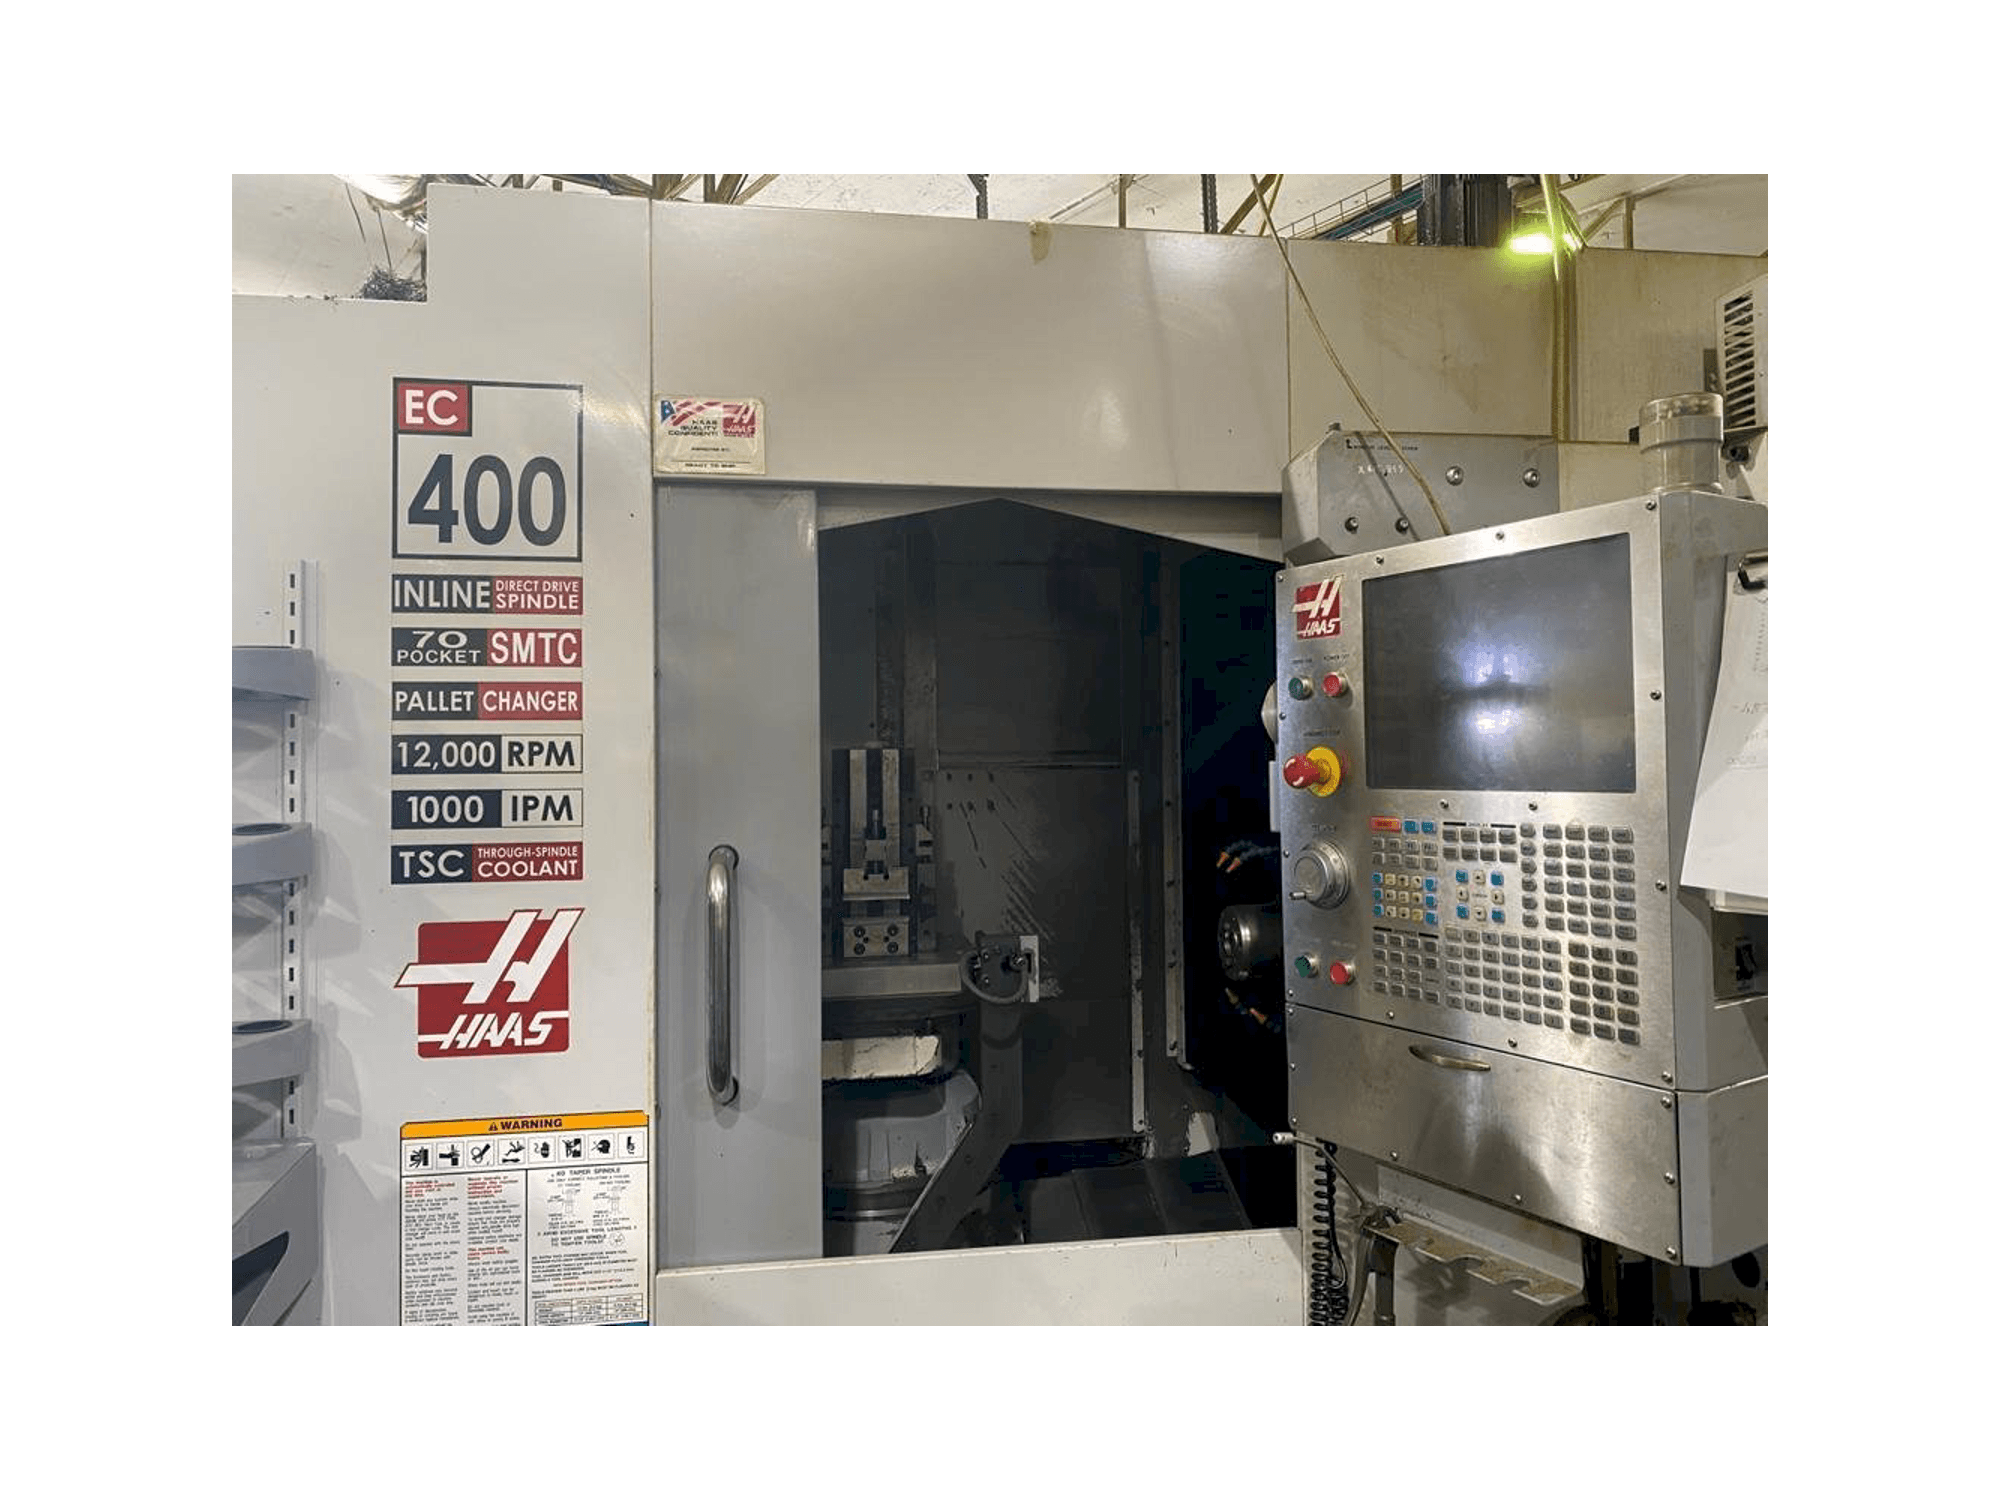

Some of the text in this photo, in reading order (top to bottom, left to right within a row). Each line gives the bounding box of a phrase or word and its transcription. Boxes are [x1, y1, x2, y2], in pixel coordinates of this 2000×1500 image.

[405, 389, 459, 425] EC
[408, 454, 566, 546] 400
[394, 580, 490, 608] INLINE
[496, 580, 579, 592] DIRECT DRIVE
[496, 593, 578, 609] SPINDLE
[1302, 619, 1339, 637] HAAS
[412, 630, 468, 649] 70
[490, 631, 577, 664] SMTC
[396, 650, 481, 664] POCKET
[395, 690, 578, 712] PALLET CHANGER
[397, 740, 575, 771] 12,000 RPM
[407, 794, 573, 823] 1000 IPM
[478, 846, 578, 858] THROUGH-SPINDLE
[399, 850, 464, 878] TSC
[477, 860, 578, 878] COOLANT
[430, 1011, 558, 1050] HAAS
[500, 1118, 563, 1130] WARNING
